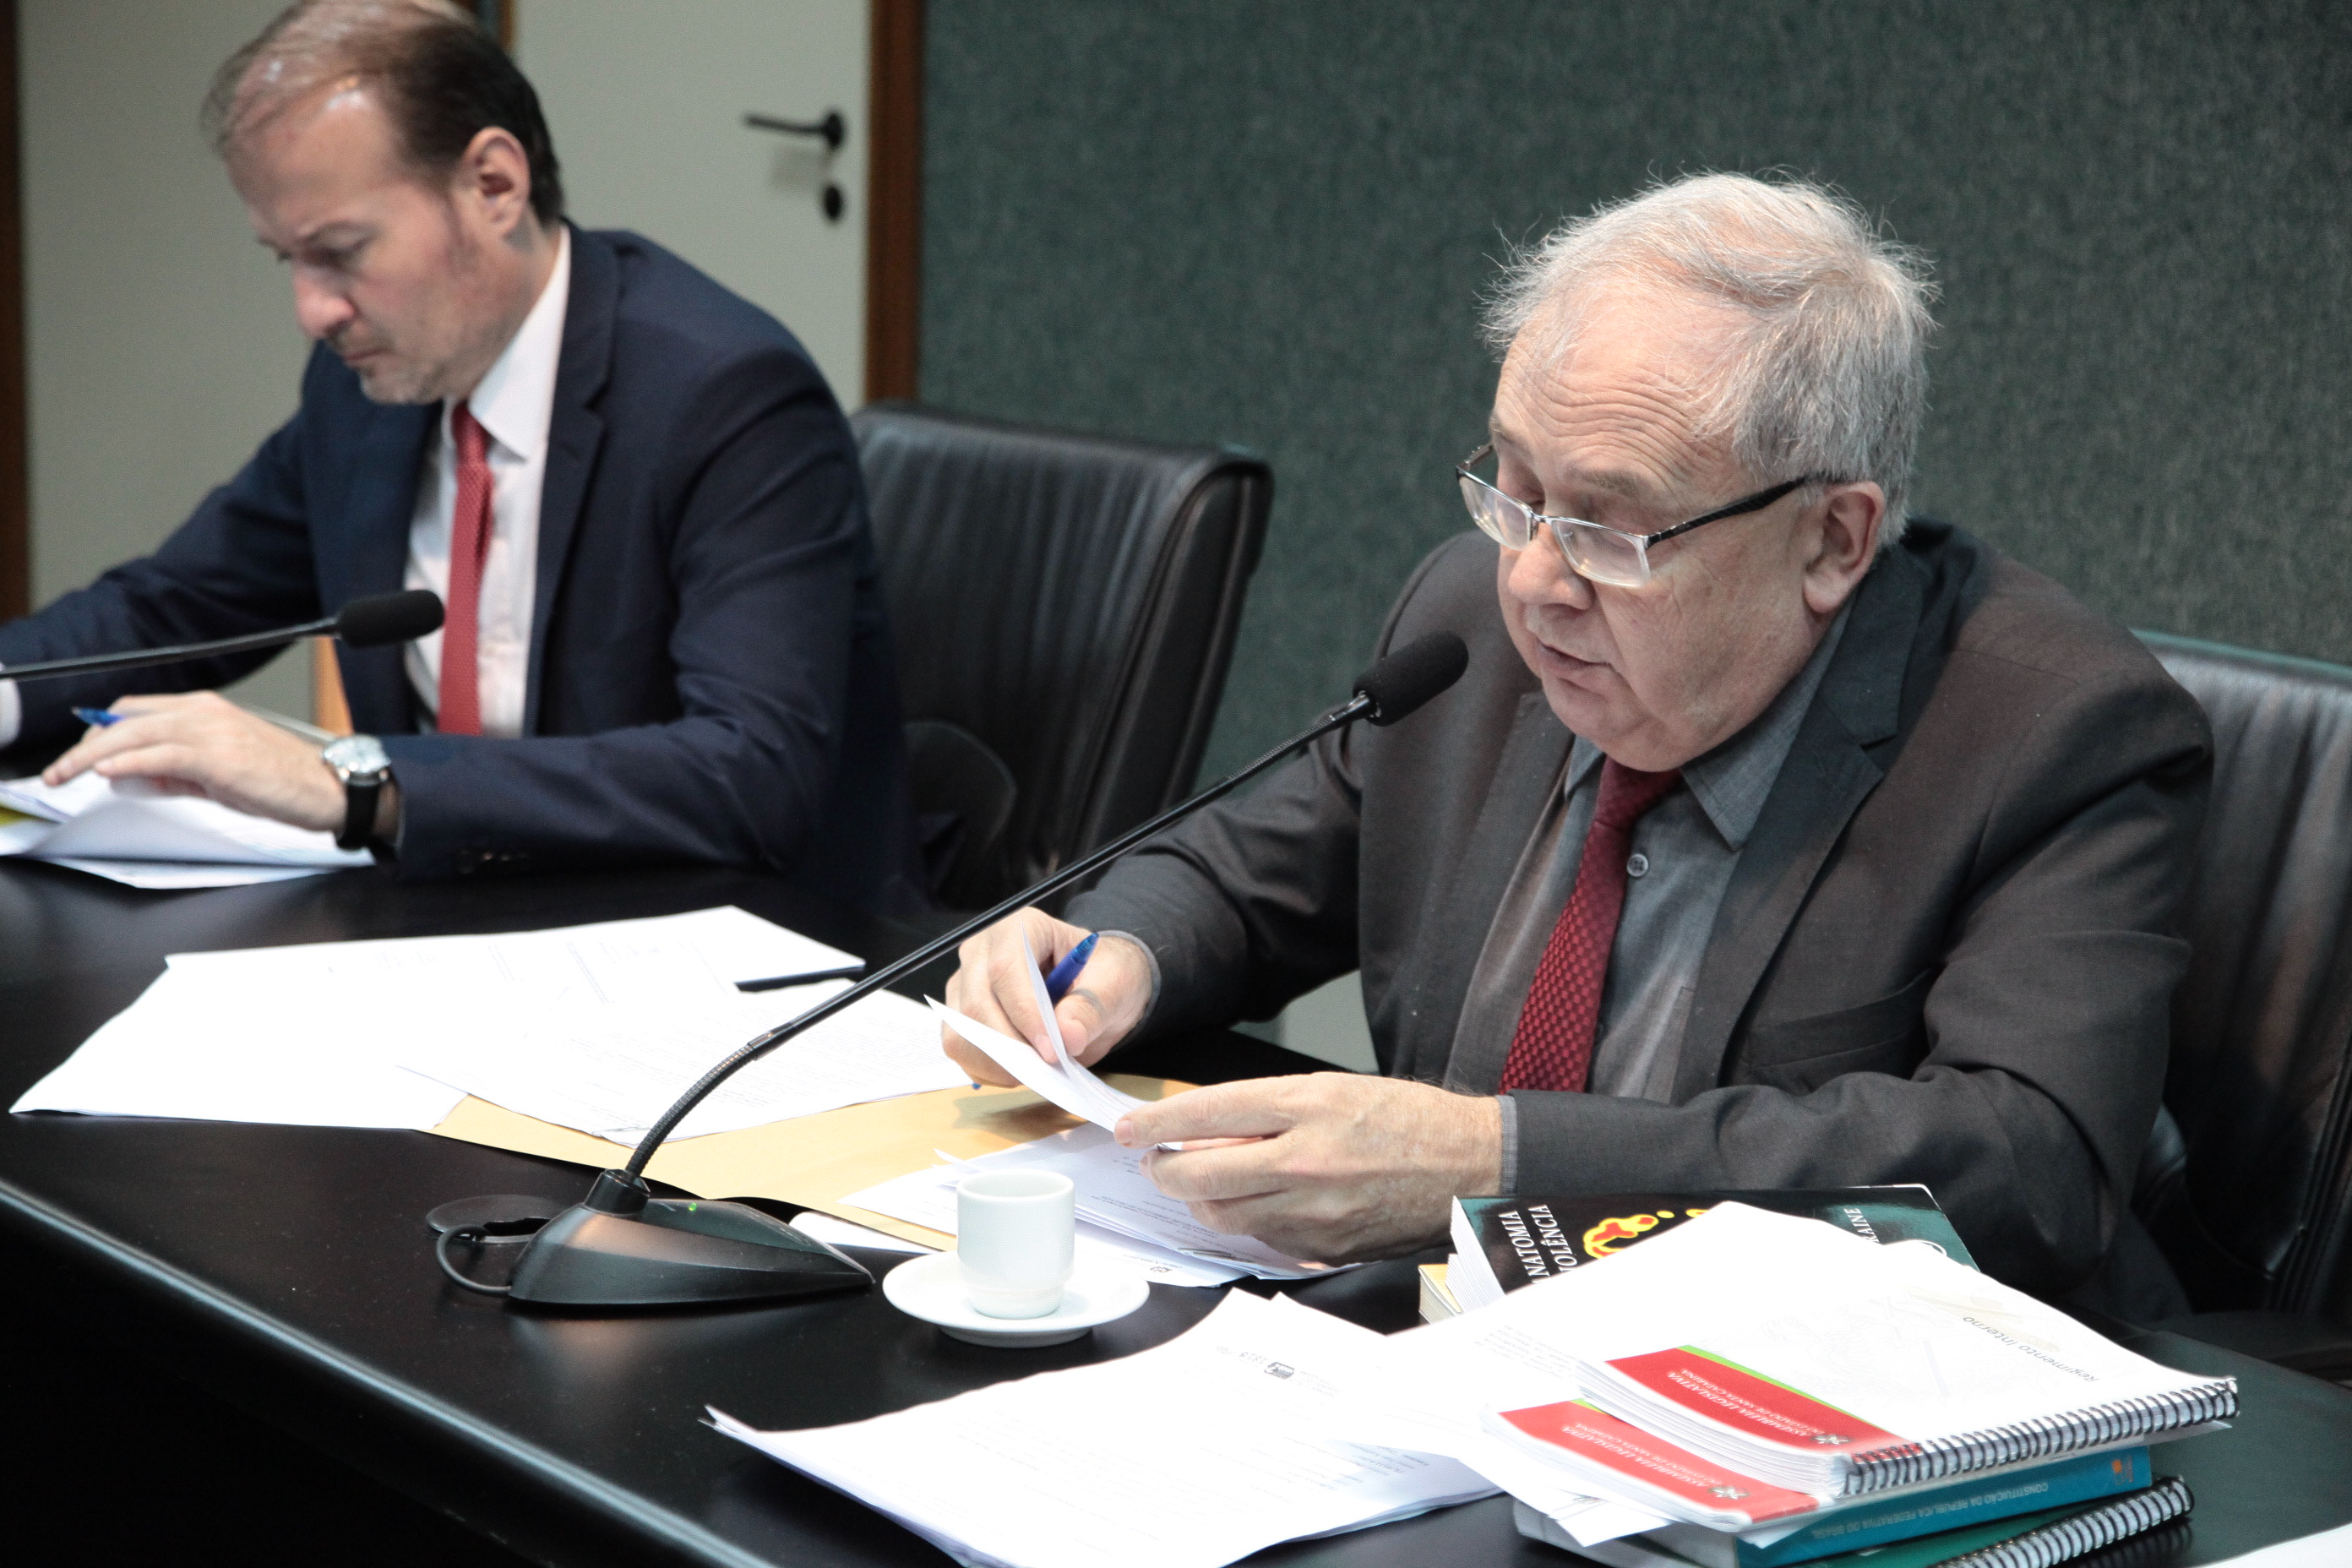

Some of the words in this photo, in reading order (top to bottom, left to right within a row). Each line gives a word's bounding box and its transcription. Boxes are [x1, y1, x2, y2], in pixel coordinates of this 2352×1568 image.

[1498, 1211, 1551, 1284] NATOMIA
[1527, 1205, 1579, 1272] IOLÊNCIA
[1963, 1315, 2018, 1347] Interno
[2018, 1344, 2101, 1382] Regimento
[1668, 1371, 1740, 1410] LEGISLATIVA
[1680, 1369, 1727, 1395] CATARINA
[1725, 1392, 1756, 1409] SANTA
[1739, 1408, 1812, 1437] ASSEMBLEIA
[1562, 1425, 1636, 1458] LEGISLATIVA
